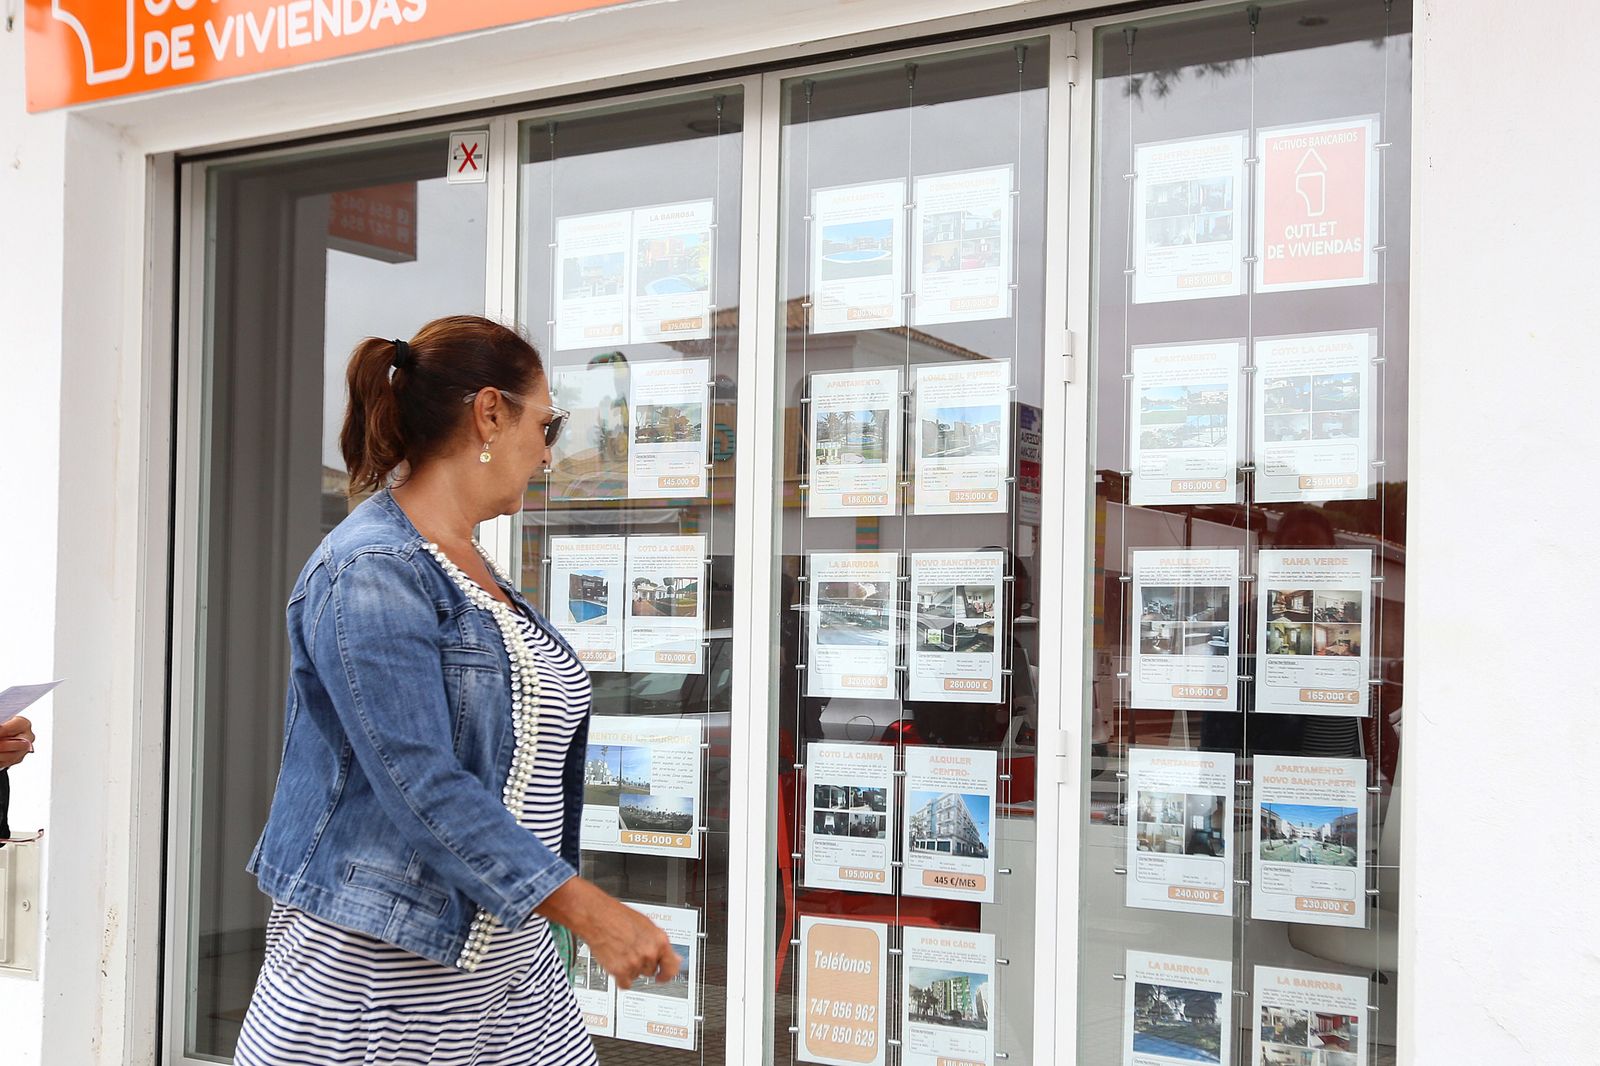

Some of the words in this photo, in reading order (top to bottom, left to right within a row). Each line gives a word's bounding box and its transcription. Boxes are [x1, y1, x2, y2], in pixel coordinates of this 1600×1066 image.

[144, 23, 195, 76] DE
[204, 0, 428, 61] VIVIENDAS
[1272, 138, 1307, 152] ACTIVOS
[1308, 132, 1358, 146] BANCARIOS
[660, 210, 695, 220] BARROSA
[1285, 222, 1337, 240] OUTLET
[1268, 244, 1284, 259] DE
[1288, 237, 1362, 257] VIVIENDAS
[1271, 346, 1298, 355] COTO
[1301, 346, 1315, 354] LA
[1317, 343, 1354, 353] CAMPA
[1215, 481, 1221, 489] €
[988, 492, 993, 500] €
[841, 560, 879, 568] BARROSA
[940, 559, 999, 567] SANCTI-PETRI
[1313, 557, 1350, 566] VERDE
[1179, 687, 1214, 696] 210.000
[1307, 691, 1344, 700] 165.000
[1346, 692, 1353, 701] €
[819, 750, 841, 758] COTO
[855, 752, 884, 760] CAMPA
[929, 755, 972, 765] ALQUILER
[1150, 758, 1215, 769] APARTAMENTO
[1275, 765, 1344, 775] APARTAMENTO
[1263, 776, 1289, 785] NOVO
[1291, 777, 1357, 788] SANCTI-PETRI
[628, 834, 672, 845] 185.000
[676, 837, 683, 845] €
[844, 869, 874, 879] 195.000
[876, 872, 880, 880] €
[933, 877, 948, 886] 445
[950, 877, 976, 887] €/MES
[1175, 889, 1211, 900] 240.000
[1213, 892, 1219, 900] €
[1303, 900, 1341, 911] 230.000
[1343, 903, 1349, 912] €
[940, 939, 951, 947] EN
[814, 950, 872, 974] Teléfonos
[1147, 960, 1161, 970] LA
[1163, 961, 1210, 976] BARROSA
[1277, 976, 1292, 986] LA
[1294, 978, 1343, 992] BARROSA
[811, 999, 830, 1015] 747
[832, 1003, 851, 1019] 856
[855, 1005, 875, 1022] 962
[810, 1023, 830, 1040] 747
[831, 1027, 851, 1044] 850
[854, 1029, 874, 1047] 629
